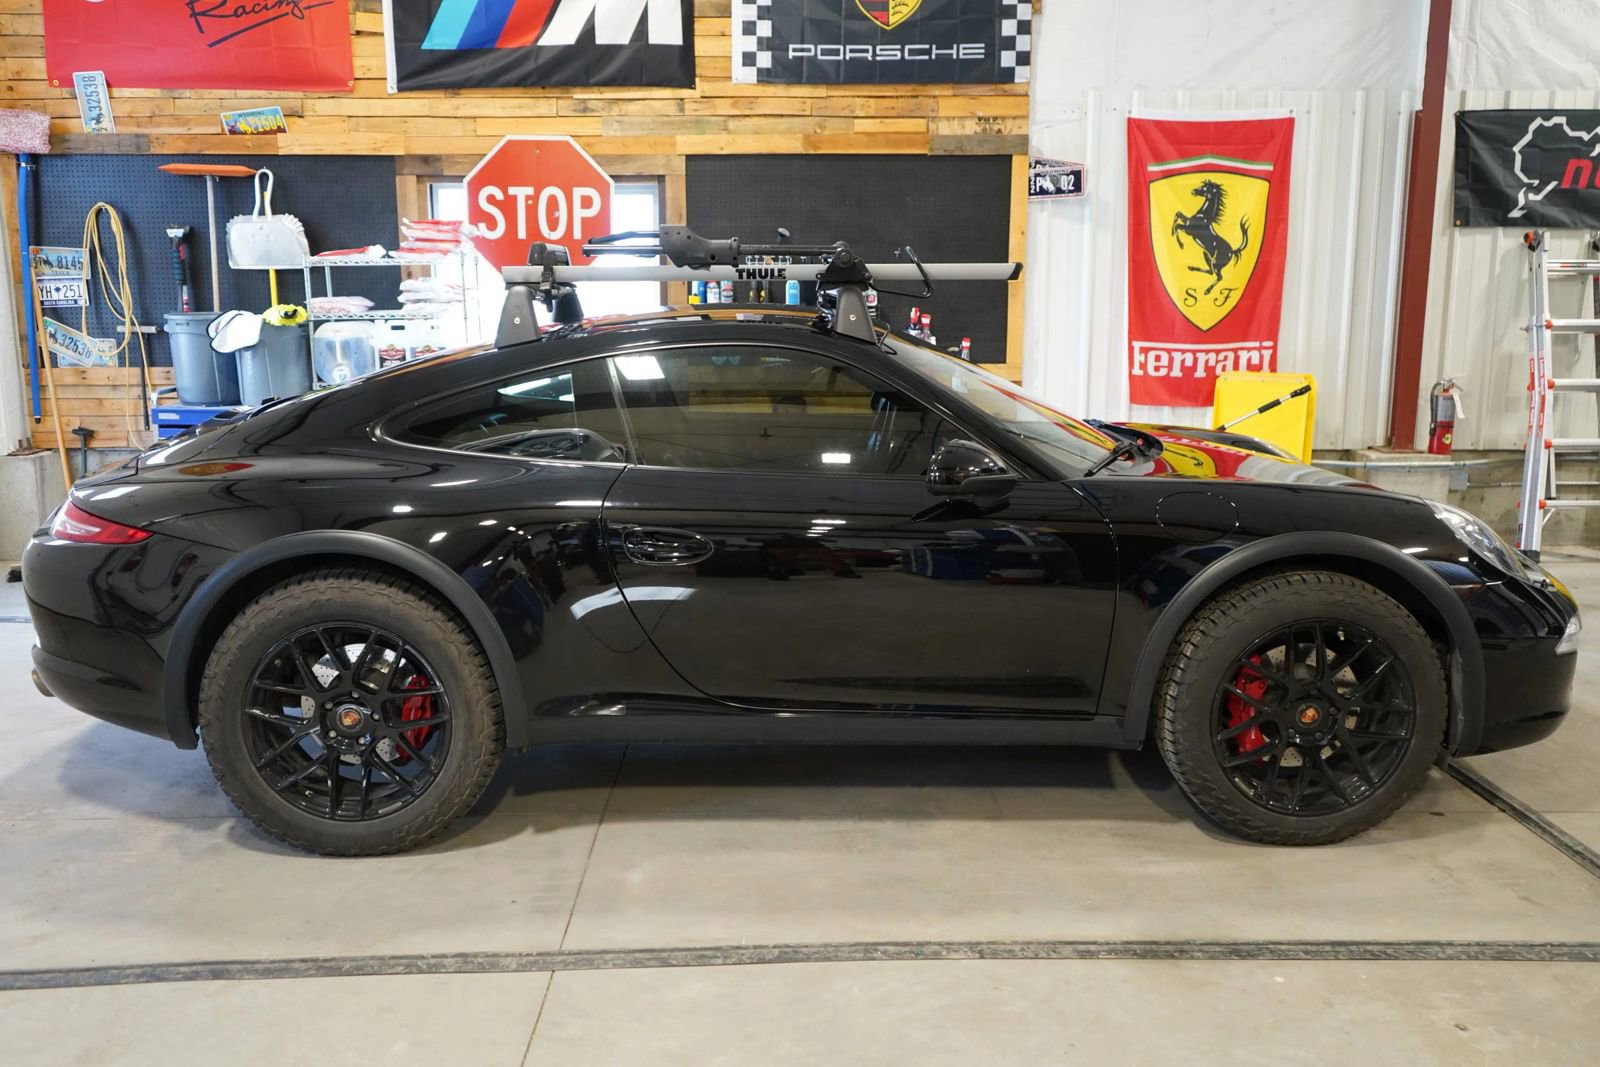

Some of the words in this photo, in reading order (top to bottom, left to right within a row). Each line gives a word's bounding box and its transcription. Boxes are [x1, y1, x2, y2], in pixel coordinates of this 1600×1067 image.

[788, 43, 986, 61] PORSCHE
[477, 185, 602, 240] STOP
[735, 268, 786, 280] THULE
[62, 284, 83, 299] 251
[1183, 287, 1198, 308] S
[1131, 340, 1275, 378] Ferrari
